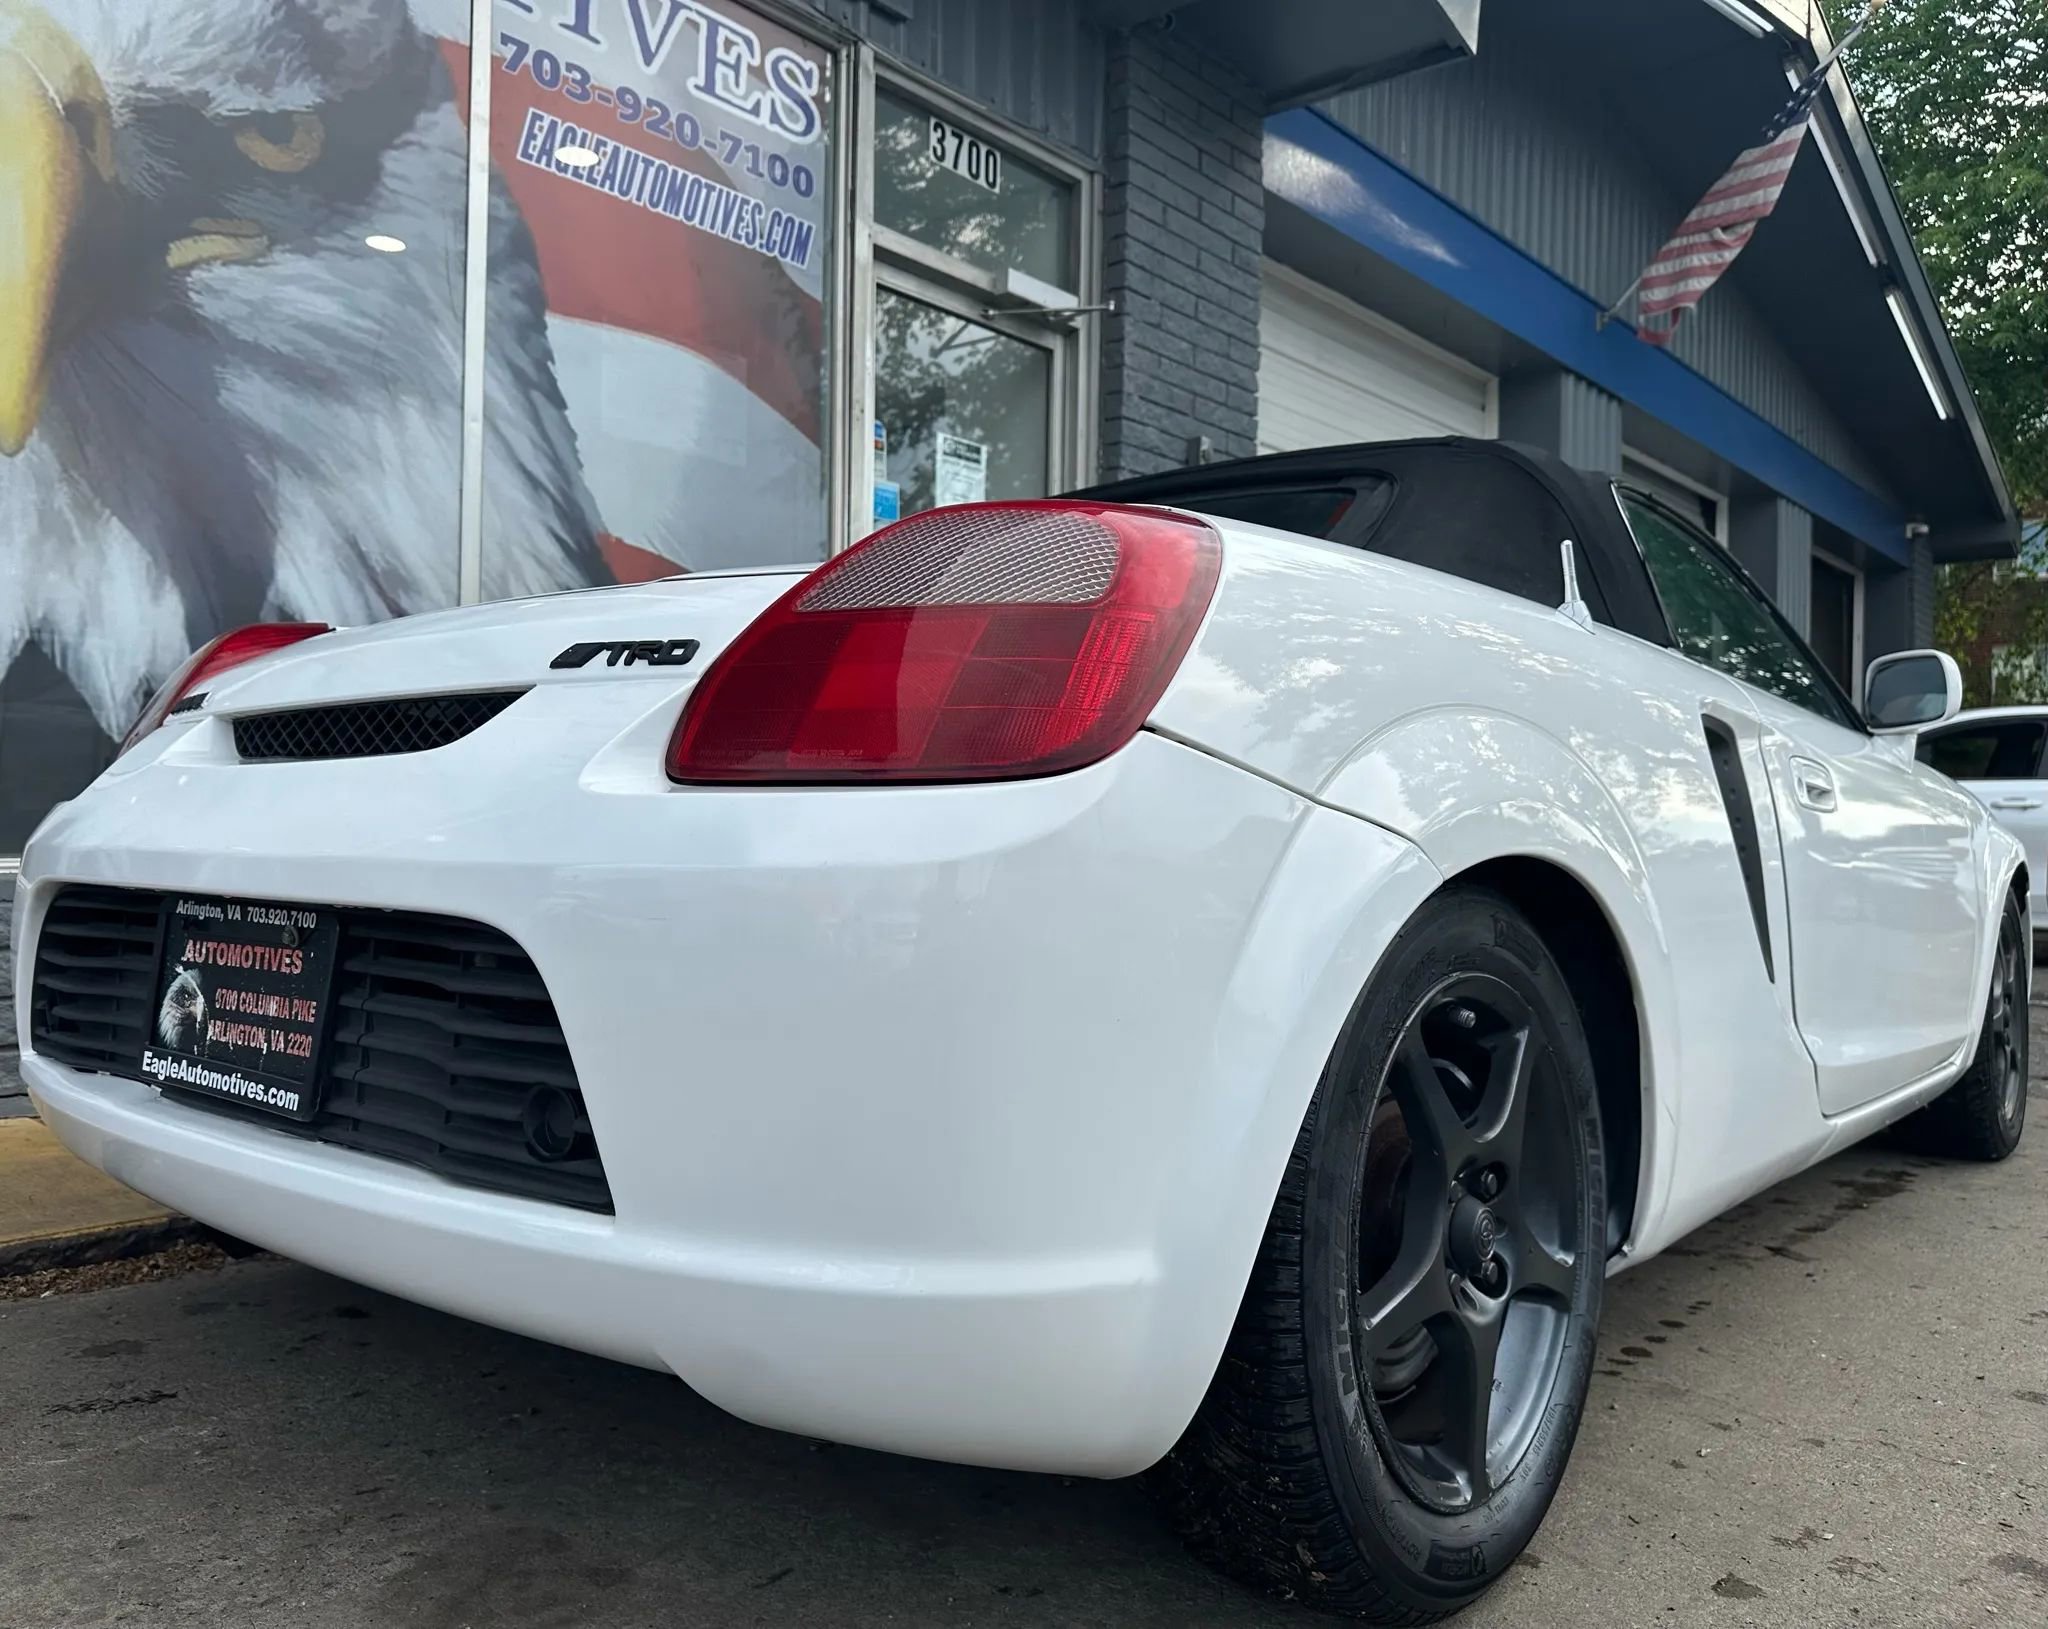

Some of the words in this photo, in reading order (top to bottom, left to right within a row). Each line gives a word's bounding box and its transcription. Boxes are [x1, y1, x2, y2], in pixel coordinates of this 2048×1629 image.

[500, 31, 815, 199] 703-920-7100
[931, 121, 999, 190] 3700
[601, 639, 700, 667] TRD
[176, 899, 224, 922] Arlington,
[227, 904, 242, 921] VA
[247, 907, 317, 929] 703.920.7100
[182, 939, 303, 975] AUTOMOTIVES
[239, 991, 290, 1020] COLUMBIA
[292, 998, 317, 1023] PIKE
[270, 1029, 285, 1053] VA
[286, 1032, 313, 1058] 2220
[142, 1051, 300, 1112] EagleAutomotives.com
